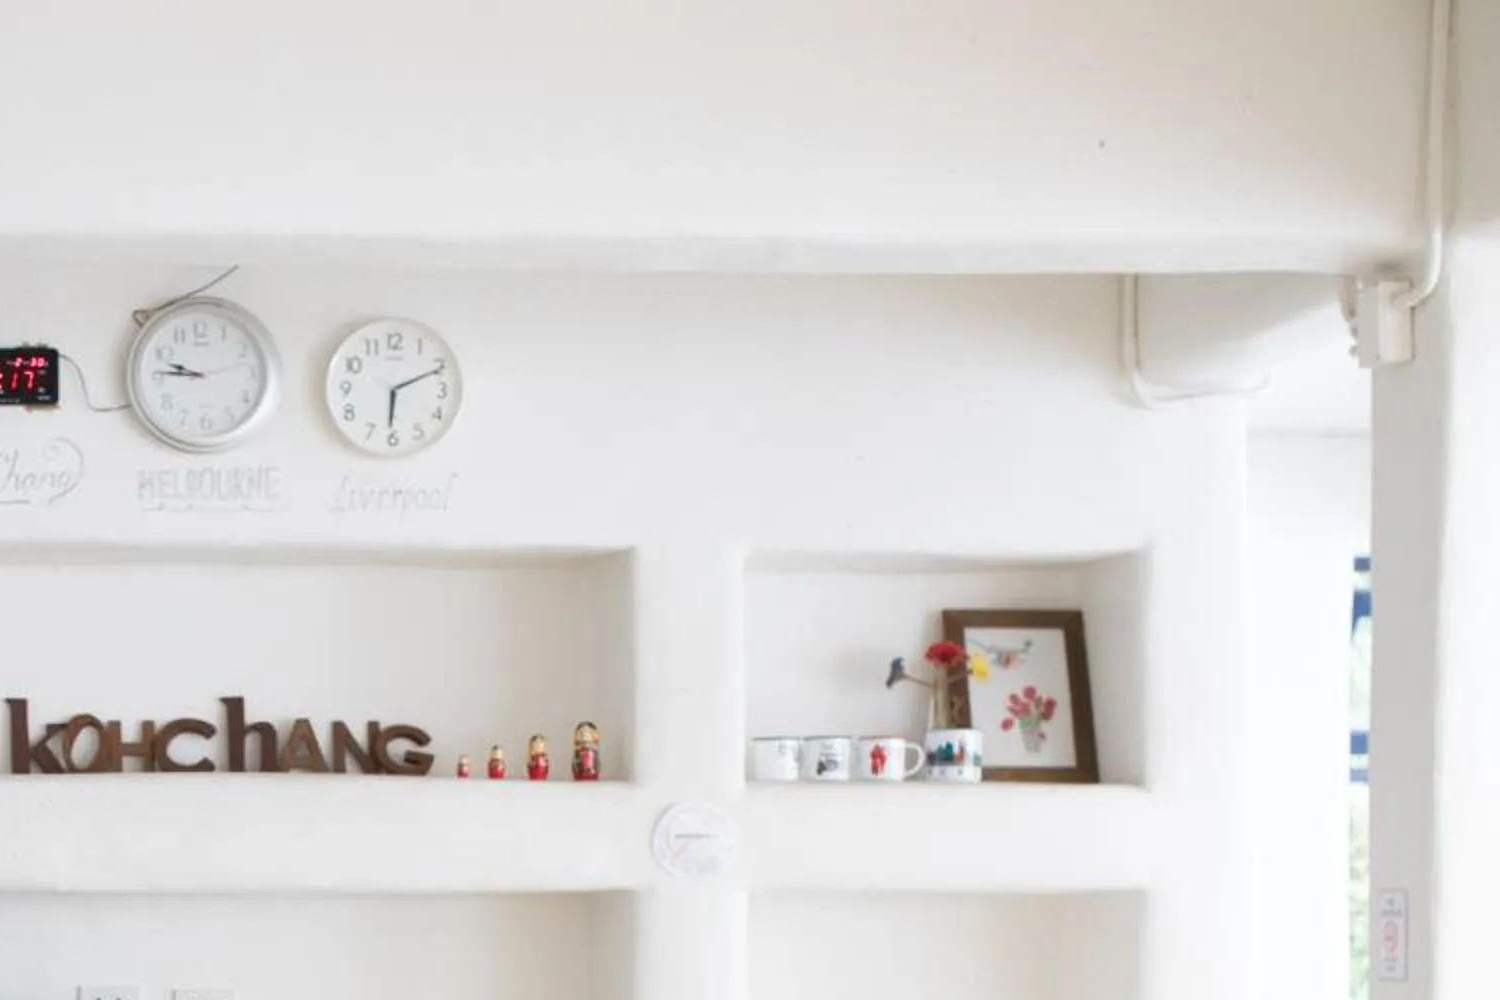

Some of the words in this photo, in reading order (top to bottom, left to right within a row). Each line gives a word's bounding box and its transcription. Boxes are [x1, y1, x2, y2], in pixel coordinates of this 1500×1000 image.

[173, 325, 186, 344] 11
[386, 332, 403, 351] 12
[365, 338, 379, 356] 11
[345, 355, 362, 375] 10
[433, 357, 446, 375] 2
[339, 380, 352, 398] 9
[437, 381, 448, 399] 3
[343, 403, 356, 422] 8
[432, 405, 442, 421] 4
[364, 421, 377, 441] 7
[387, 429, 400, 447] 6
[411, 422, 425, 441] 5
[136, 464, 281, 503] MELBOURNE
